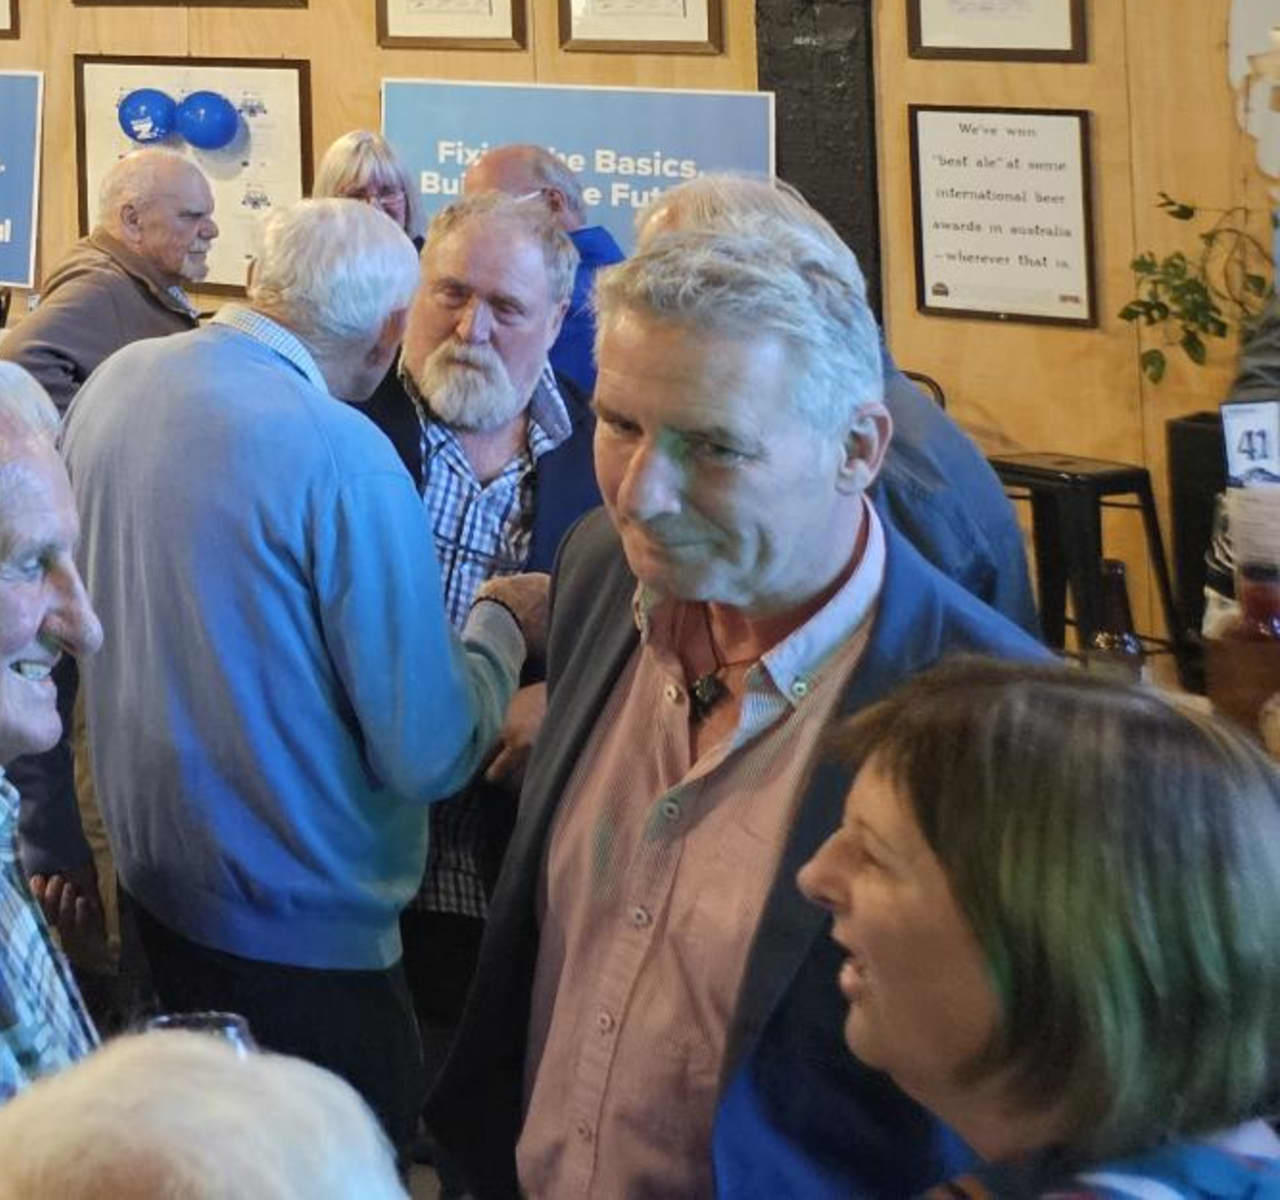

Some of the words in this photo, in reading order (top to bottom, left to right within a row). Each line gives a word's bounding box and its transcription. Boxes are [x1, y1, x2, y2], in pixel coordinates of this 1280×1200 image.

[438, 141, 488, 167] Fix
[1007, 157, 1020, 169] at
[936, 187, 1028, 204] international
[1035, 192, 1066, 205] beer
[932, 220, 982, 232] awards
[990, 224, 1003, 235] in
[1010, 223, 1073, 238] australia
[1018, 254, 1048, 268] that
[1238, 429, 1269, 461] 41
